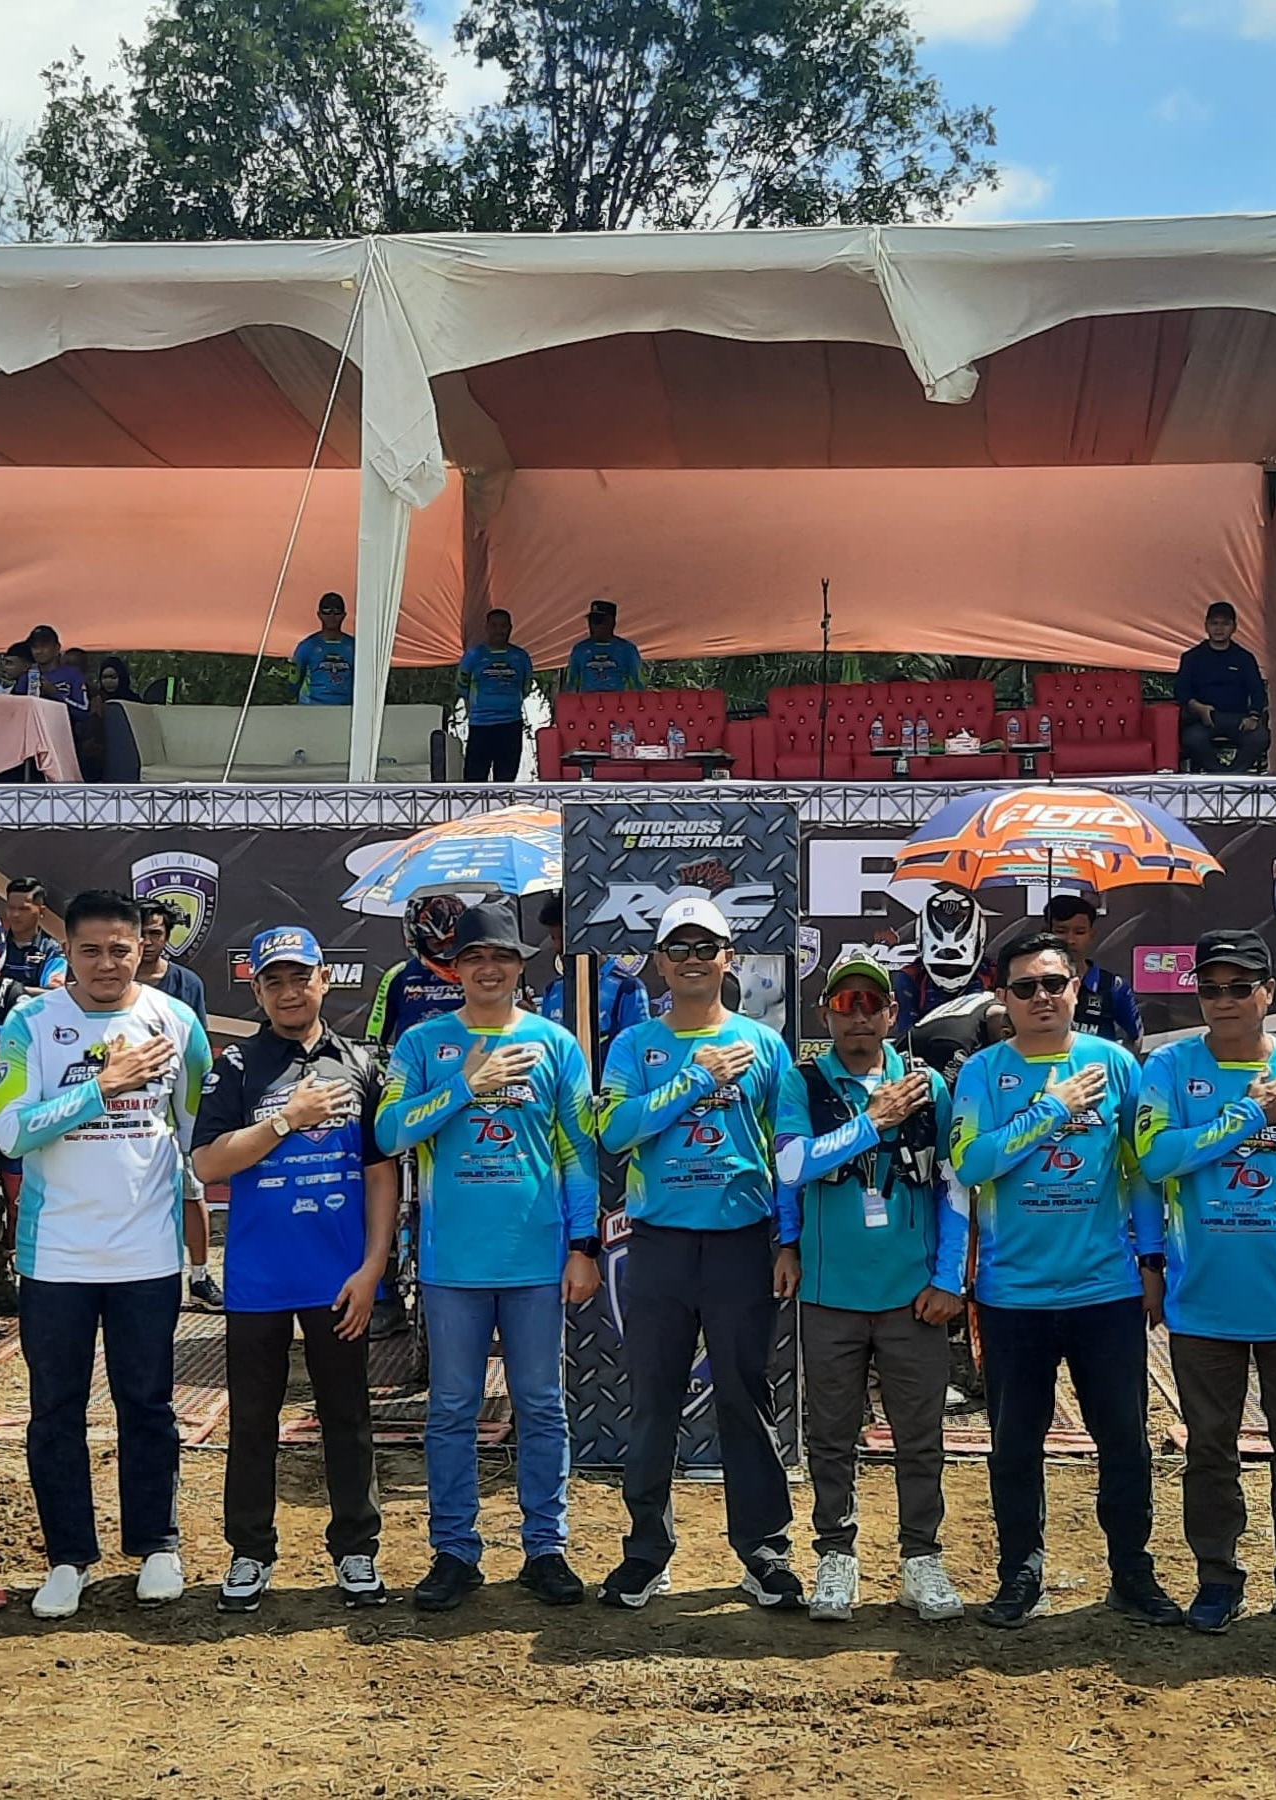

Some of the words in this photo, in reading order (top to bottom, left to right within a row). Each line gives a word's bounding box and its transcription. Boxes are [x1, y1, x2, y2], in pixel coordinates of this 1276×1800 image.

[614, 820, 723, 834] MOTOCROSS
[637, 834, 747, 848] GRASSTRACK
[150, 874, 200, 887] IMI
[469, 1116, 516, 1152] 79
[678, 1120, 726, 1156] 79
[1037, 1145, 1085, 1180] 79
[1220, 1160, 1273, 1199] 79
